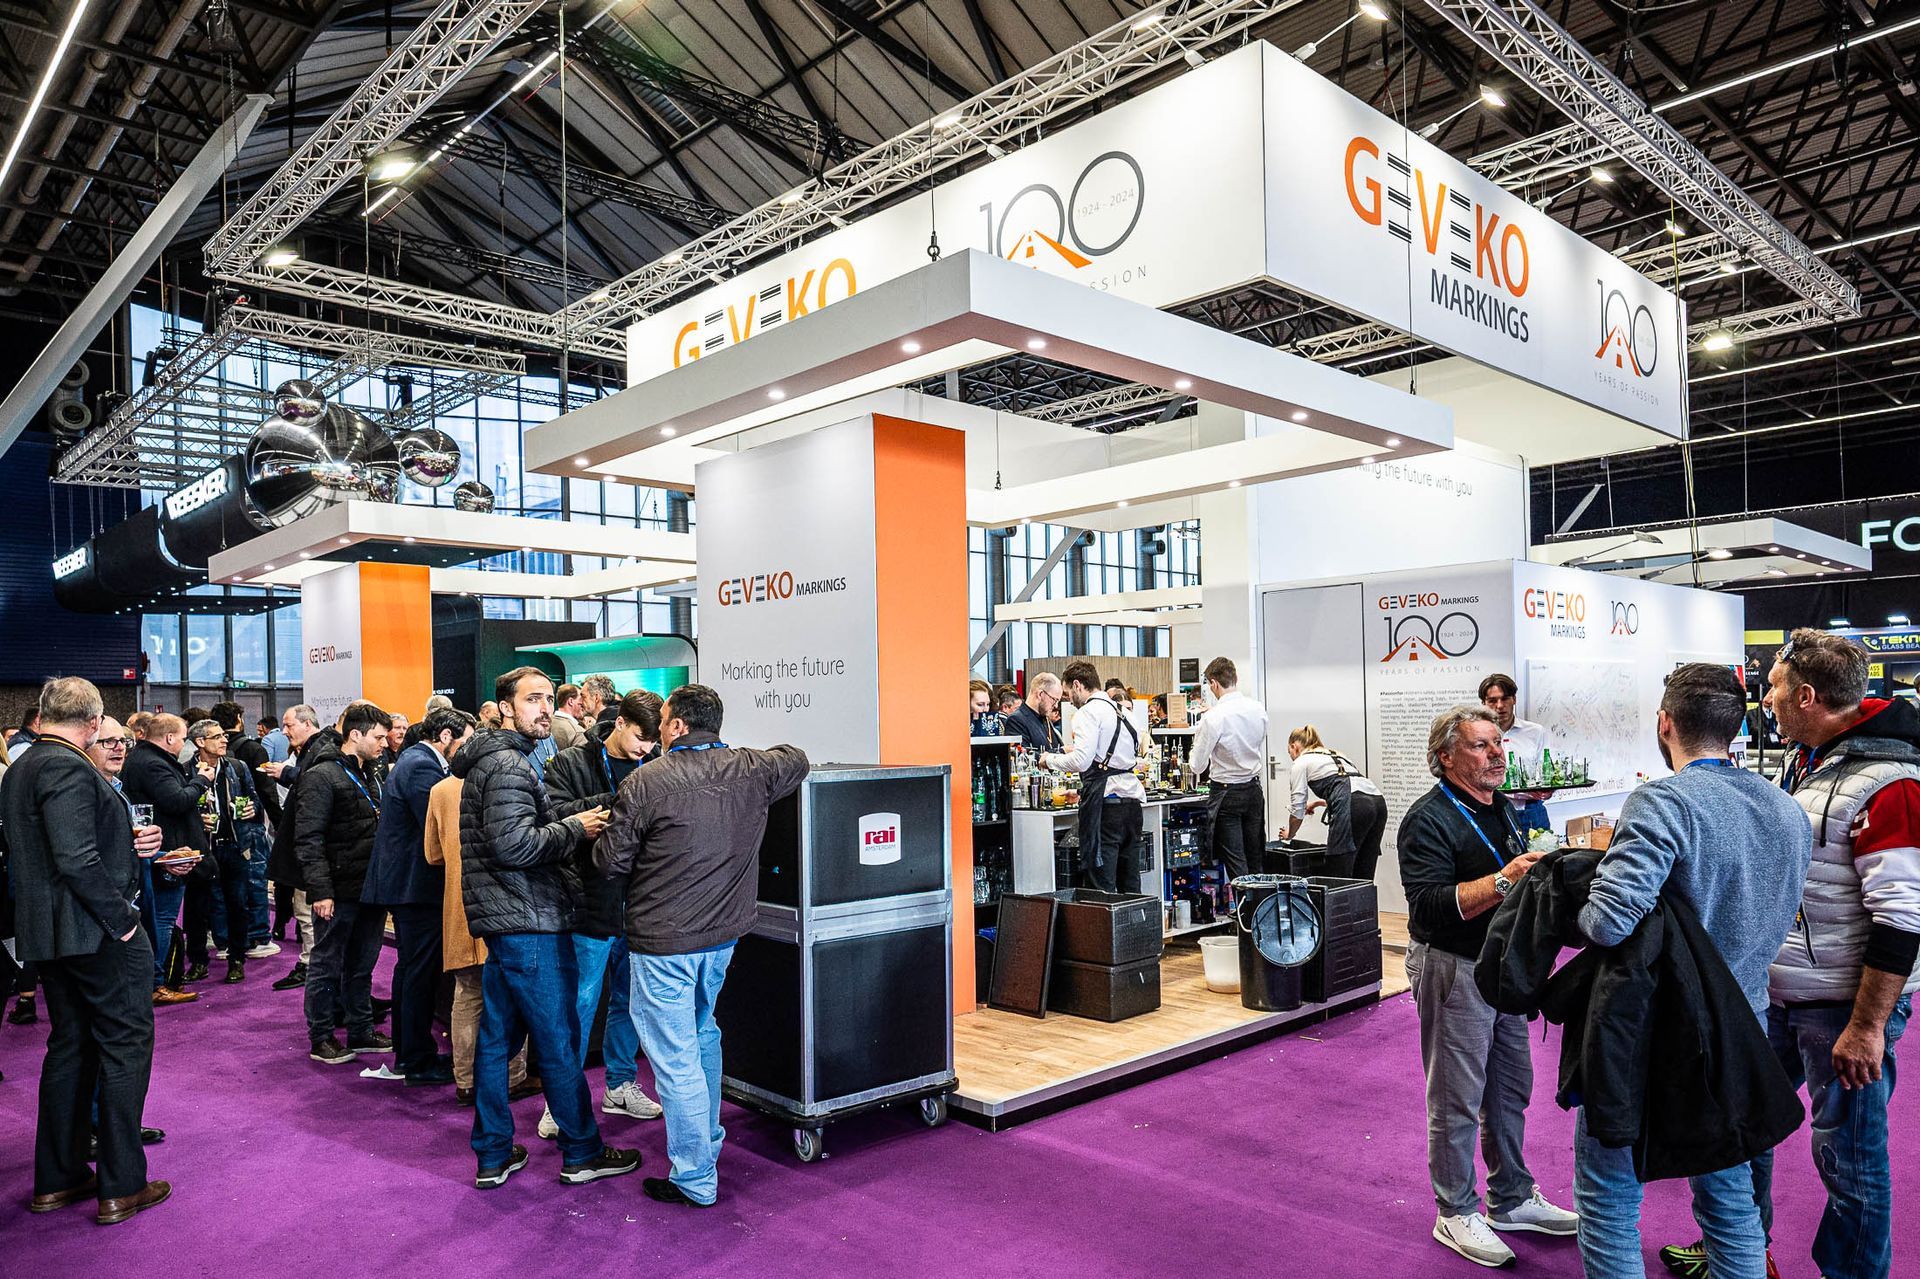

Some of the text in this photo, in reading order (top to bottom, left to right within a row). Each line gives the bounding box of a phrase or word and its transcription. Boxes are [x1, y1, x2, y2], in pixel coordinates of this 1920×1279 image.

[979, 151, 1145, 260] 100
[1077, 202, 1100, 218] 1924
[1109, 188, 1135, 206] 2024
[1344, 136, 1529, 298] GEVEKO
[673, 257, 857, 369] GEVEKO
[1431, 268, 1529, 343] MARKINGS
[1597, 278, 1657, 378] 100
[1593, 371, 1660, 406] YEARS OF PASSION
[1384, 463, 1400, 479] the
[1404, 464, 1432, 487] future
[1435, 473, 1453, 491] with
[1455, 481, 1472, 497] you
[718, 571, 847, 607] GEVEKO MARKINGS
[1378, 592, 1479, 610] GEVEKO MARKINGS
[1524, 588, 1585, 622] GEVEKO
[1551, 624, 1586, 639] MARKINGS
[1611, 600, 1639, 635] 100
[1382, 612, 1479, 658] 100
[1882, 643, 1904, 651] GLASS
[309, 645, 352, 664] GEVEKO MARKINGS
[722, 656, 845, 684] Marking the future
[1433, 665, 1480, 673] PASSION
[754, 689, 811, 713] with you
[865, 826, 896, 845] rai
